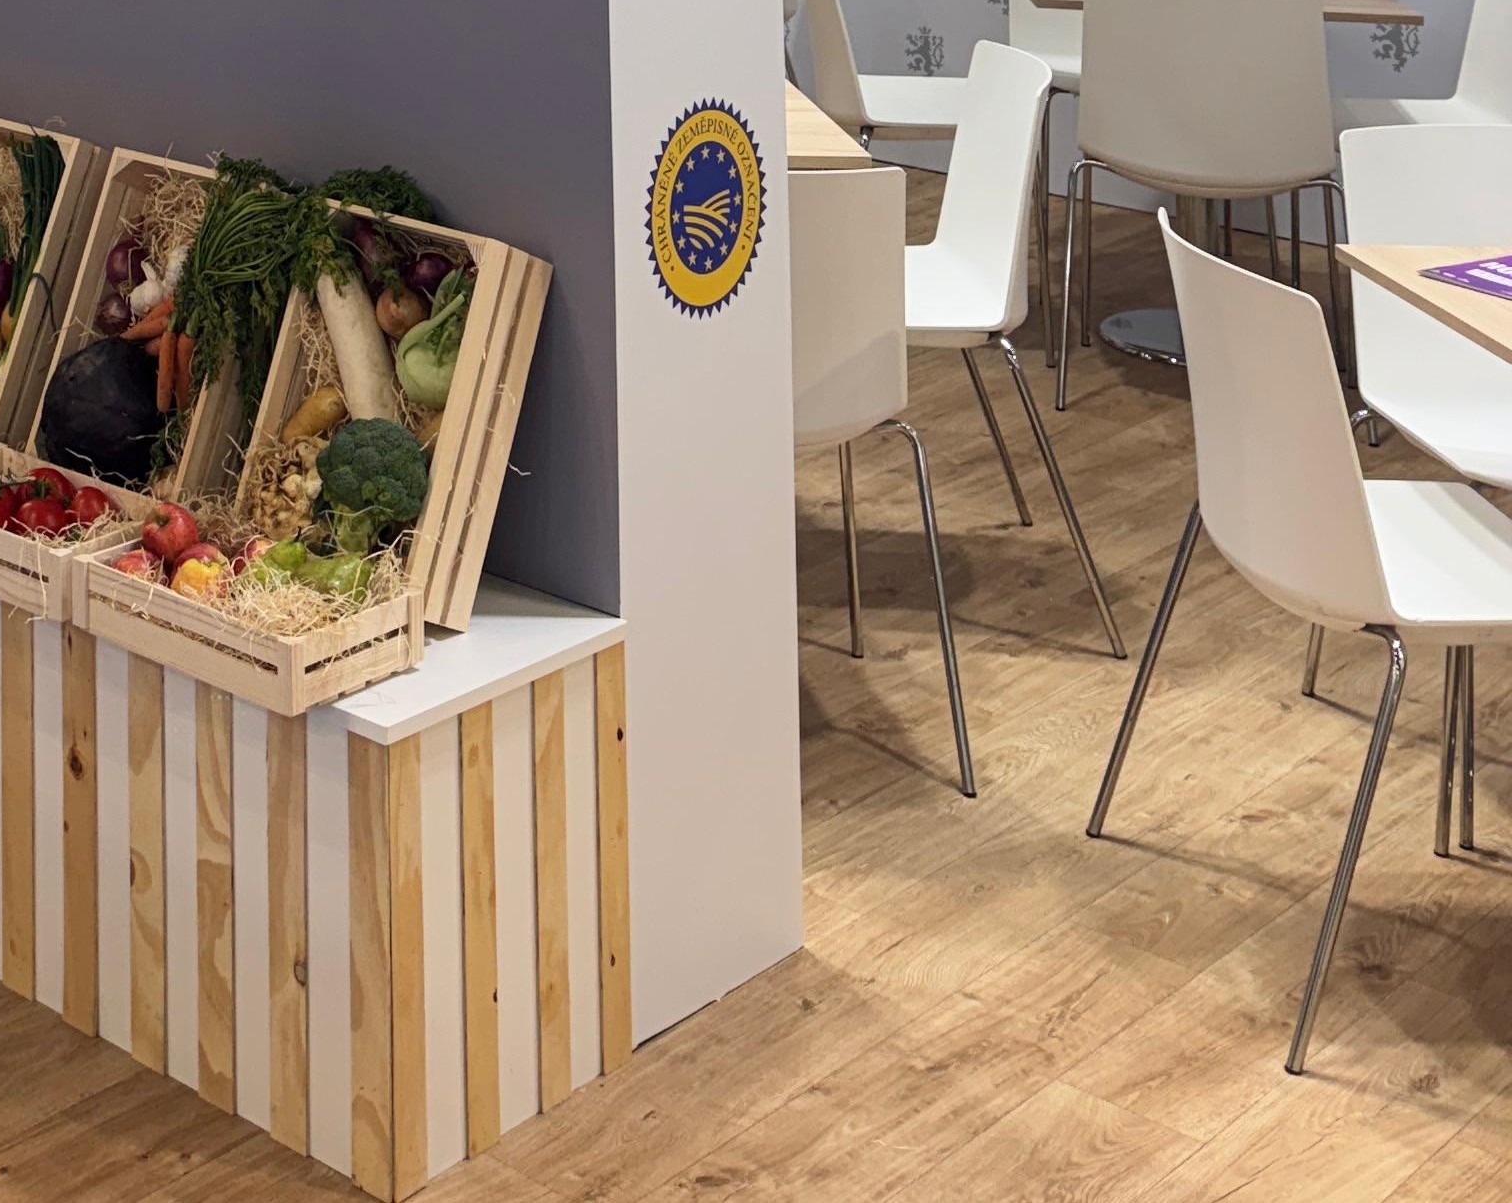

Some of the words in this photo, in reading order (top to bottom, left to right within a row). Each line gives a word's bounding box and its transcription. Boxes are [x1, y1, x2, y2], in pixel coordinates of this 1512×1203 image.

[655, 150, 679, 264] CHRÁNĚNÉ
[675, 116, 739, 154] ZEMĚPISNÉ
[737, 141, 759, 244] OZNAČENÍ
